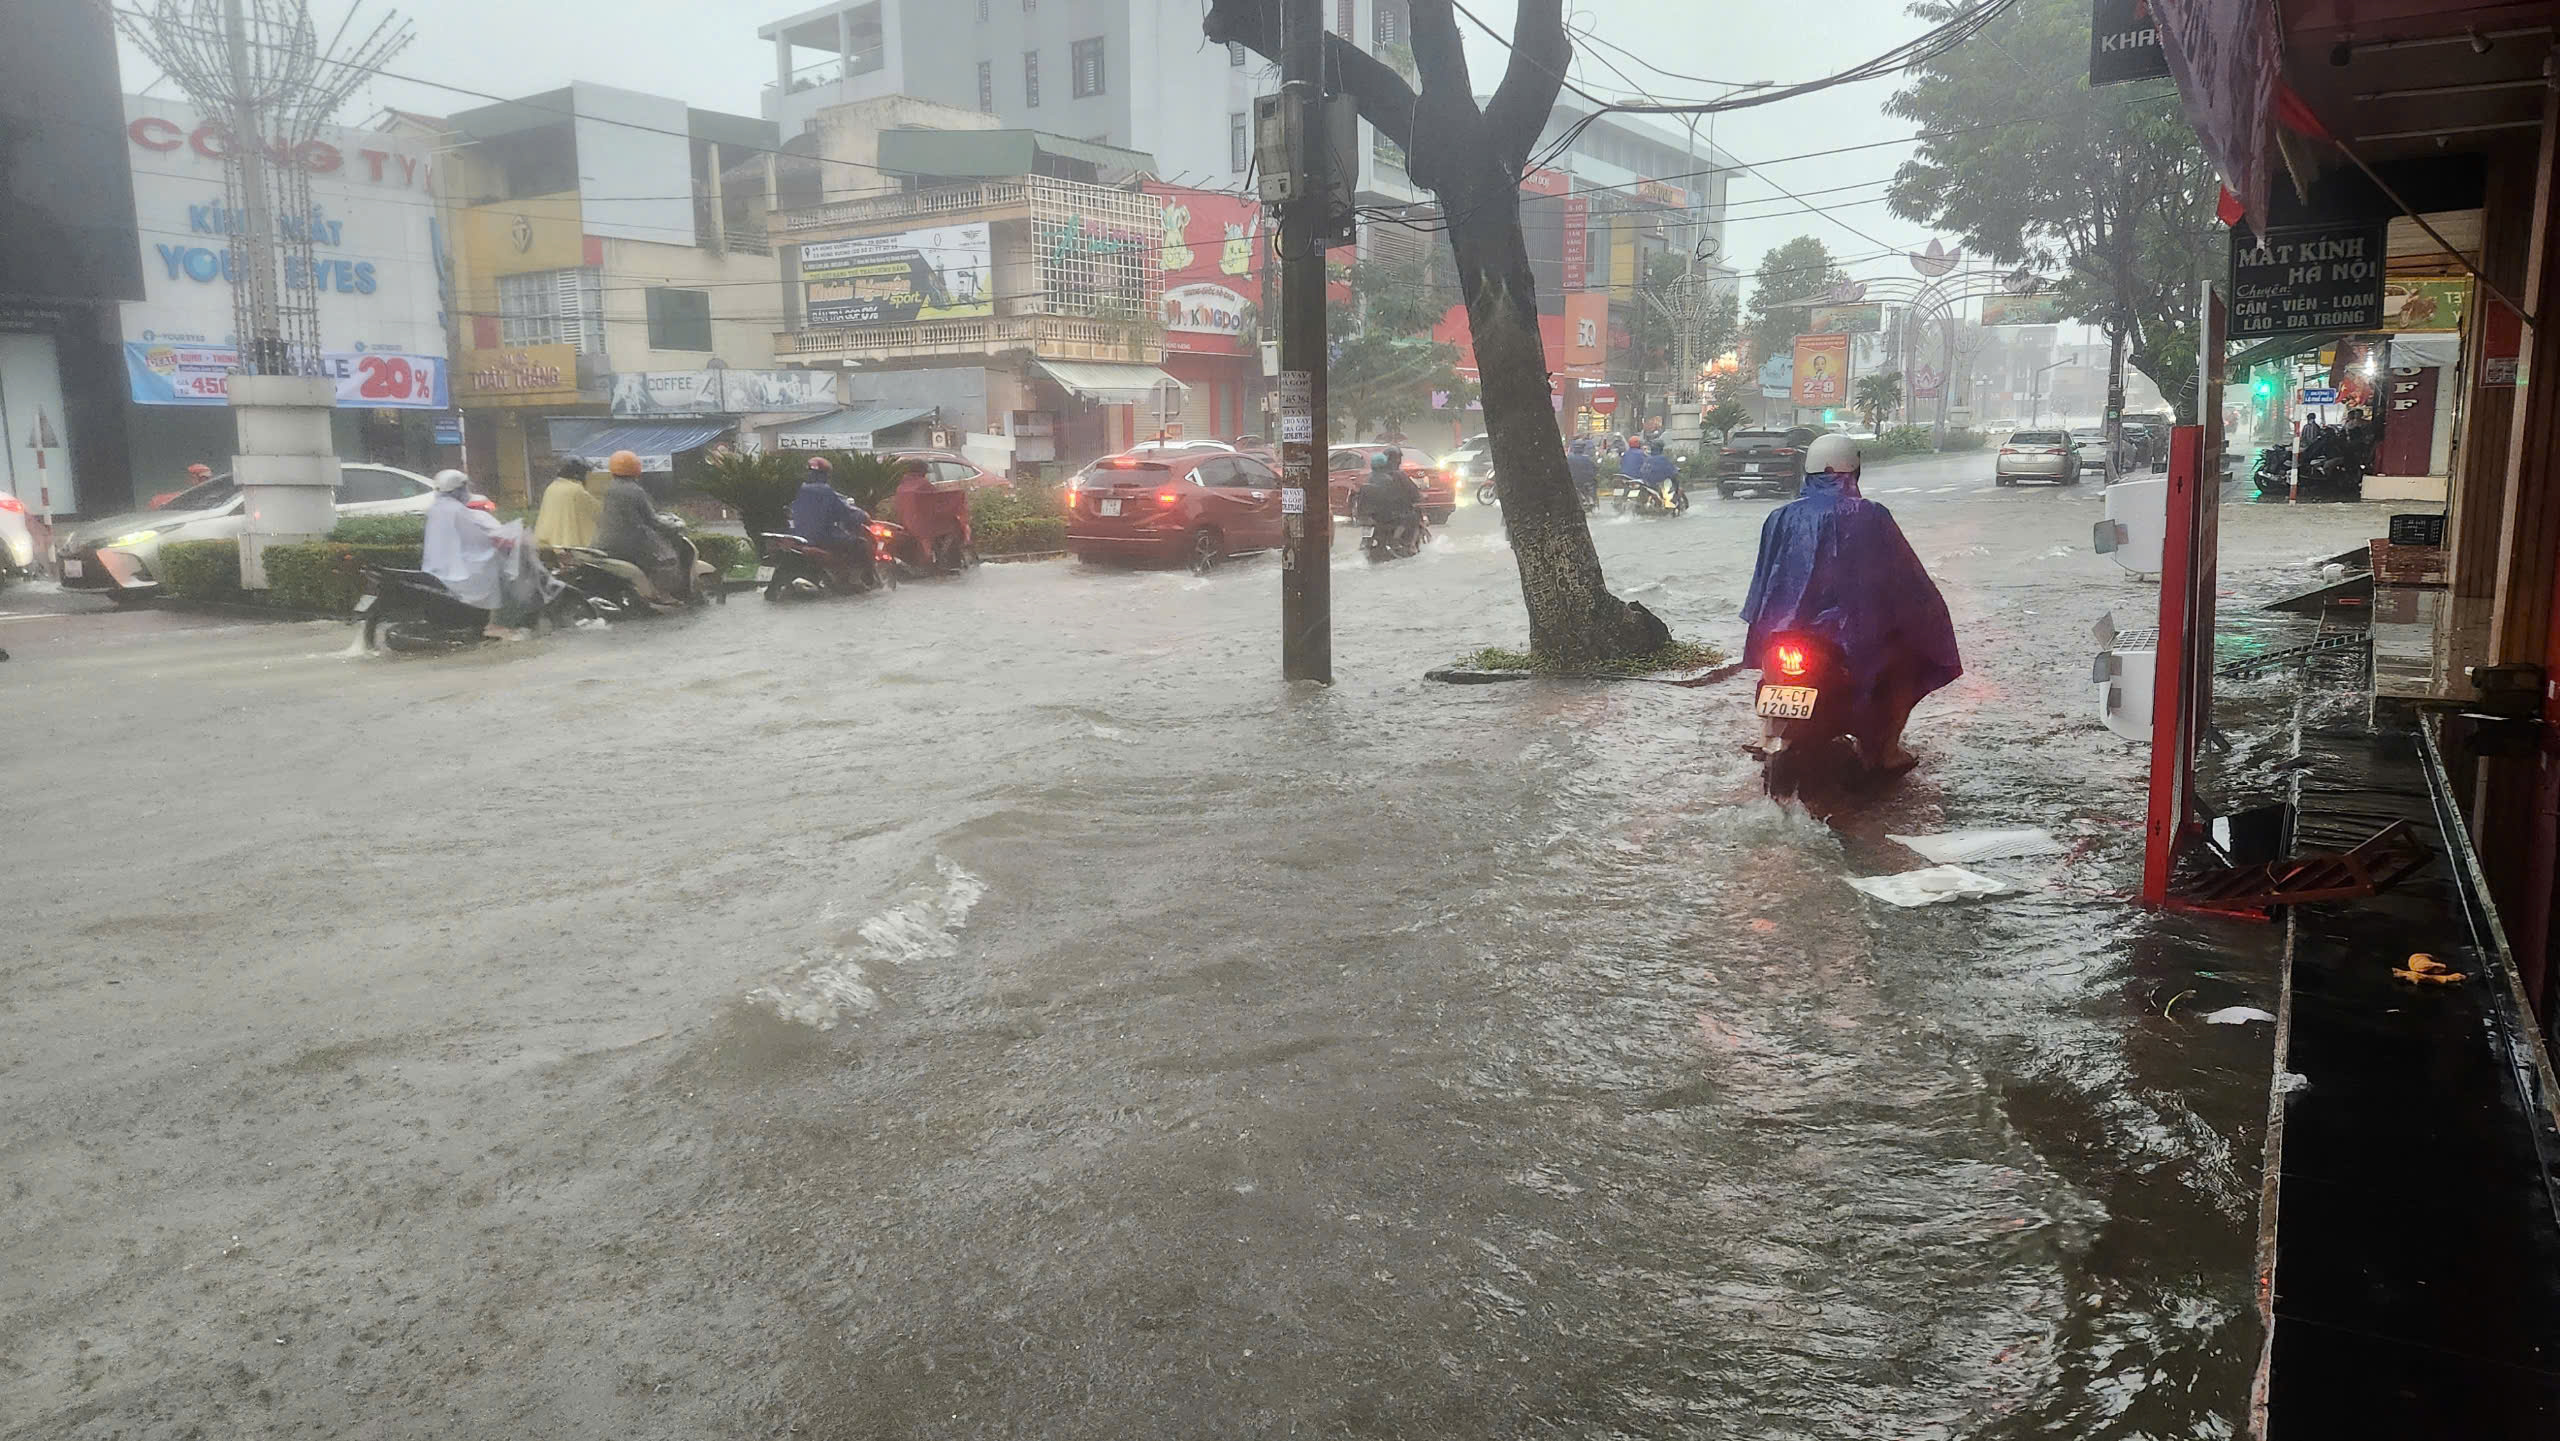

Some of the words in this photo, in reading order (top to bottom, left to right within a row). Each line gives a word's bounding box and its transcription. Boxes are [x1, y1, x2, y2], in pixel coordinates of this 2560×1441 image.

[2102, 28, 2155, 53] KHA
[2299, 234, 2365, 263] KÍNH
[286, 255, 377, 295] EYES
[2288, 261, 2322, 285] HÀ
[2332, 257, 2376, 283] NỘI
[2236, 300, 2268, 316] CẬN
[2243, 314, 2273, 331] LÃO
[648, 376, 693, 392] COFFEE
[1770, 688, 1807, 703] 74-C1
